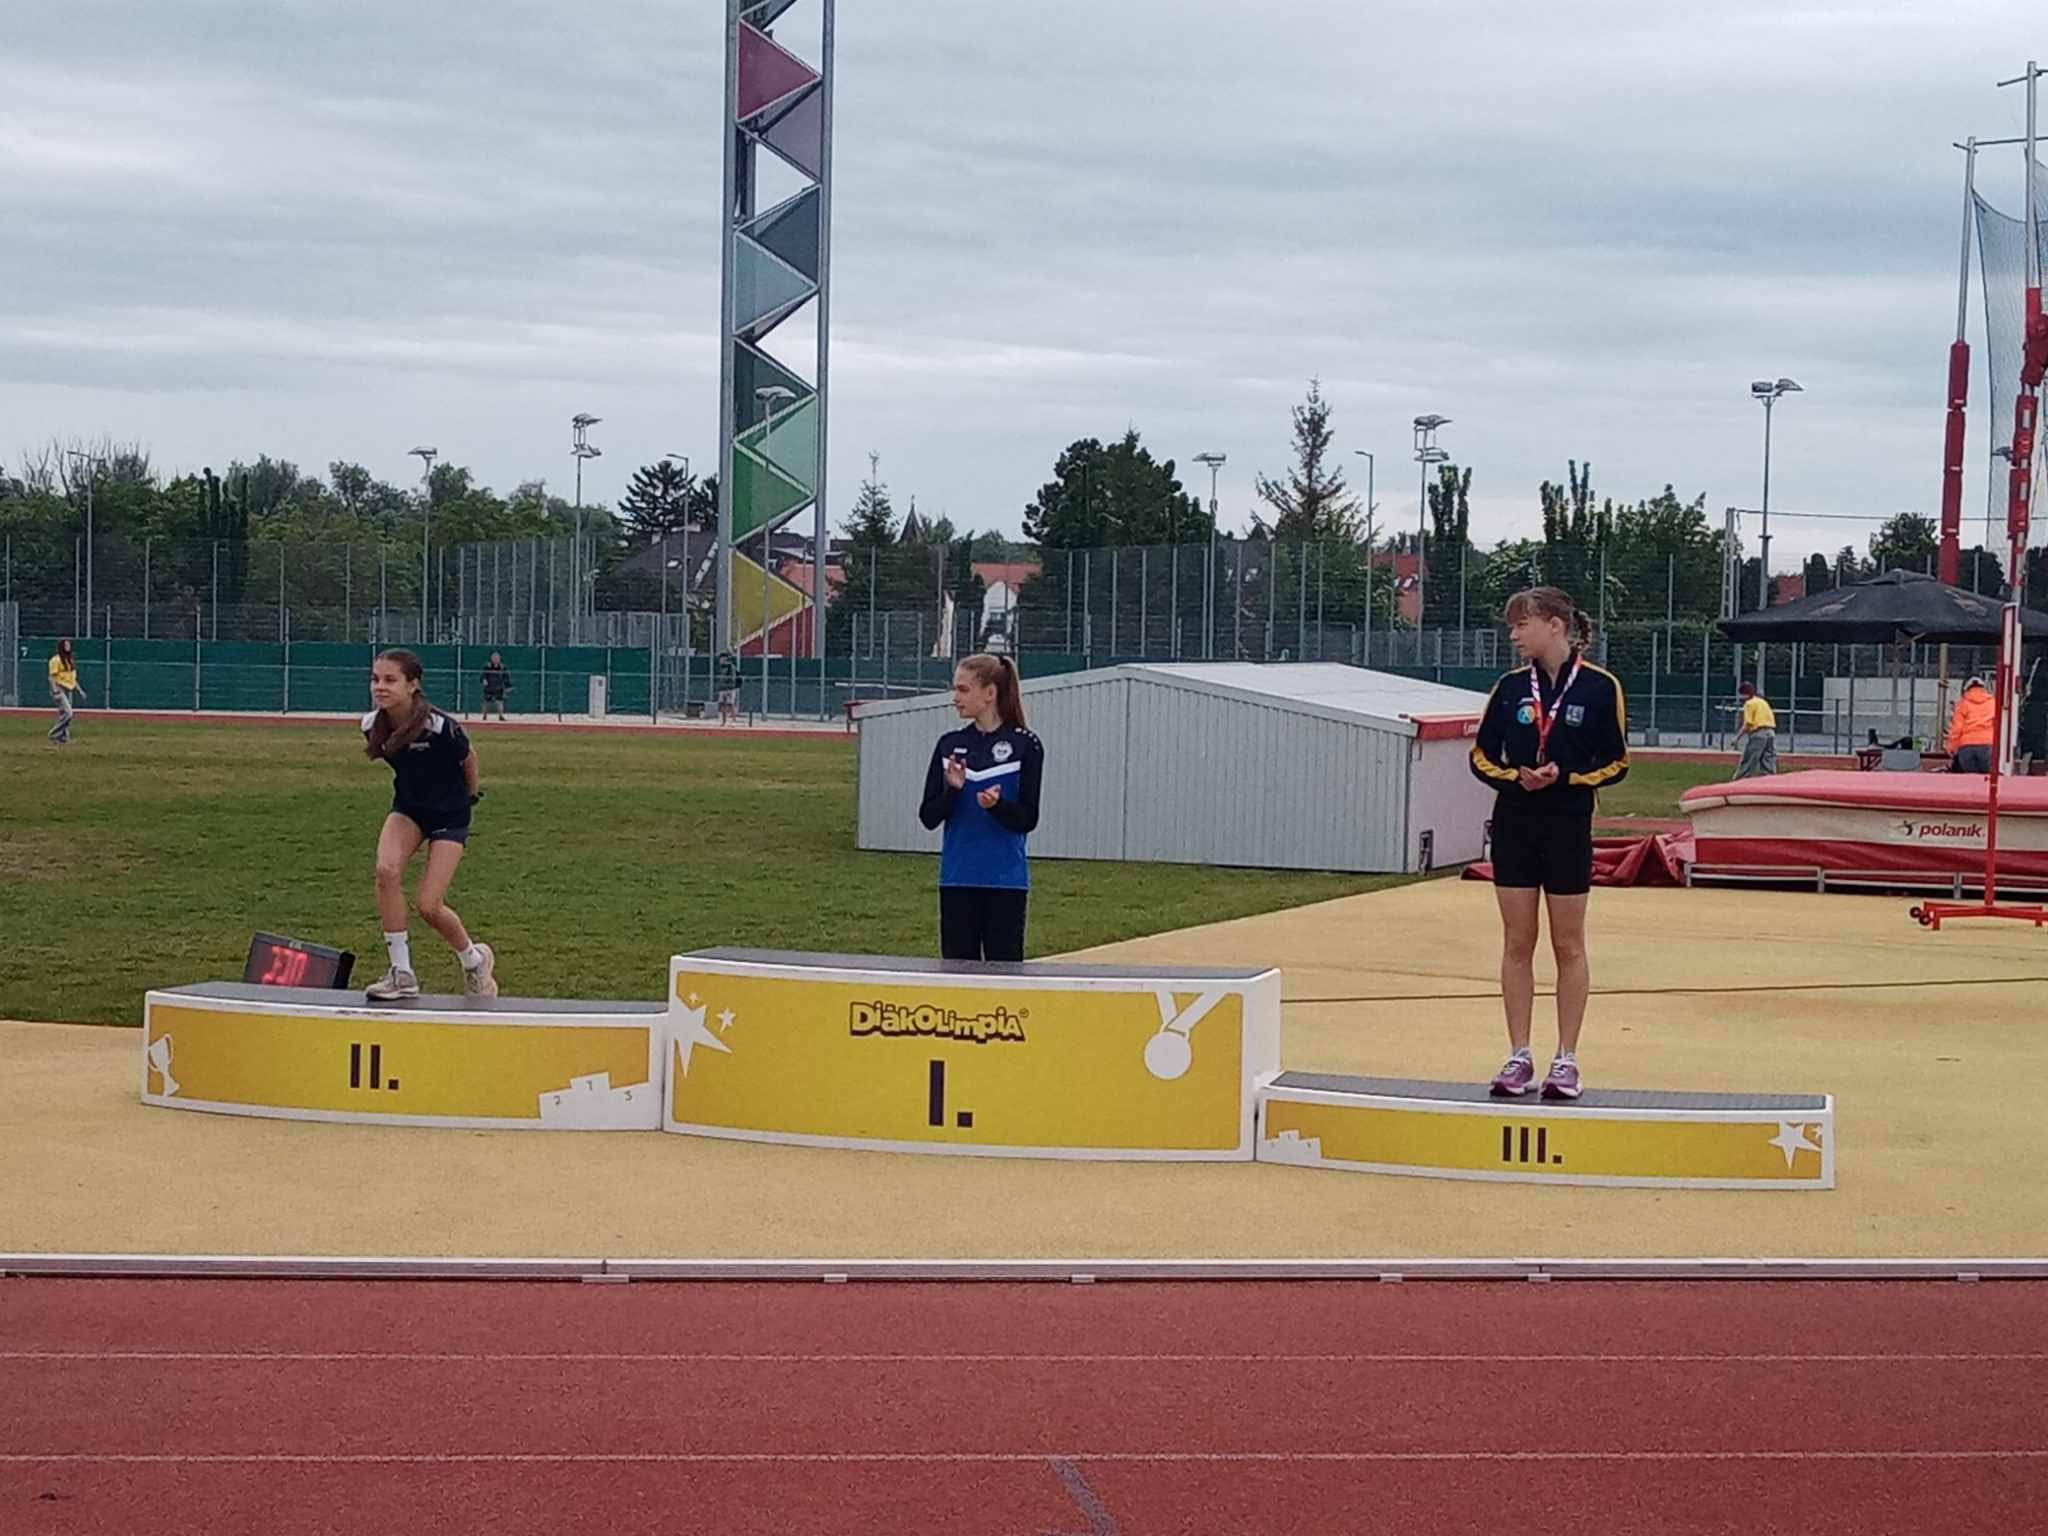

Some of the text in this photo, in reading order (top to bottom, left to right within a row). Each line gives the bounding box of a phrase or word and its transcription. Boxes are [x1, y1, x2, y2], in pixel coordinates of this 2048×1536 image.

[1919, 823, 1983, 838] polanik
[350, 1043, 399, 1090] II.
[929, 1060, 973, 1128] I.
[1503, 1126, 1562, 1165] III.
